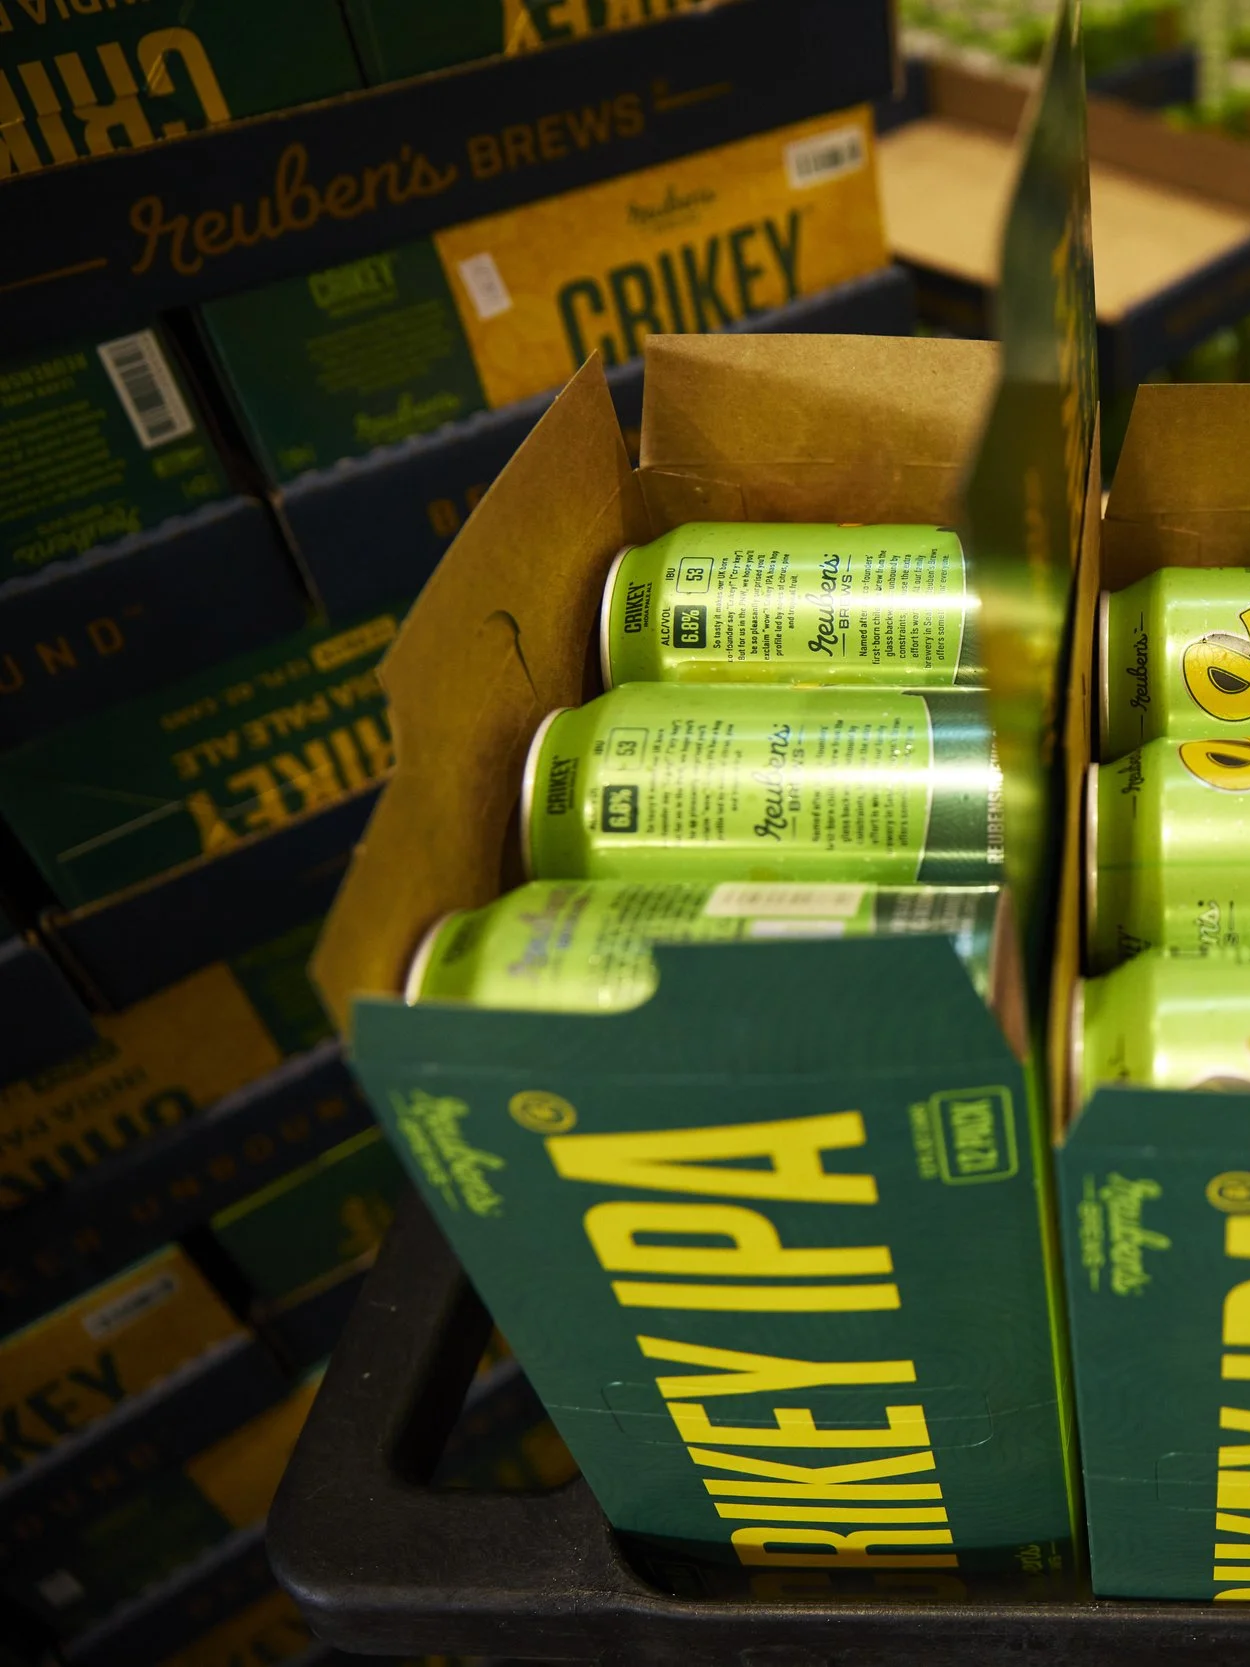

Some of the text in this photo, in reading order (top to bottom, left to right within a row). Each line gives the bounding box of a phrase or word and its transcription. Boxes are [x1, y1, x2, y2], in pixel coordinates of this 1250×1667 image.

[466, 92, 645, 182] BREWS
[557, 207, 801, 369] CRIKEY
[718, 571, 725, 579] UK
[742, 579, 749, 587] we
[661, 568, 675, 646] ALC/VOL IBU
[681, 568, 703, 643] 6.8% 53
[762, 634, 770, 660] exclaim
[766, 575, 774, 585] IPA
[770, 551, 779, 559] hop
[839, 574, 852, 629] BREWS
[727, 611, 735, 623] say
[775, 612, 784, 620] by
[787, 616, 795, 629] and
[859, 610, 868, 628] after
[714, 621, 723, 638] tasty
[739, 627, 746, 636] us
[751, 636, 757, 644] so
[713, 640, 720, 648] So
[750, 646, 757, 654] be
[775, 634, 783, 656] profile
[859, 629, 868, 656] Named
[872, 627, 880, 665] first-born
[885, 636, 896, 657] glass
[910, 636, 919, 658] effort
[924, 637, 934, 668] brewery
[936, 637, 945, 660] offers
[170, 691, 331, 783] PALE ALE
[616, 741, 637, 756] 53
